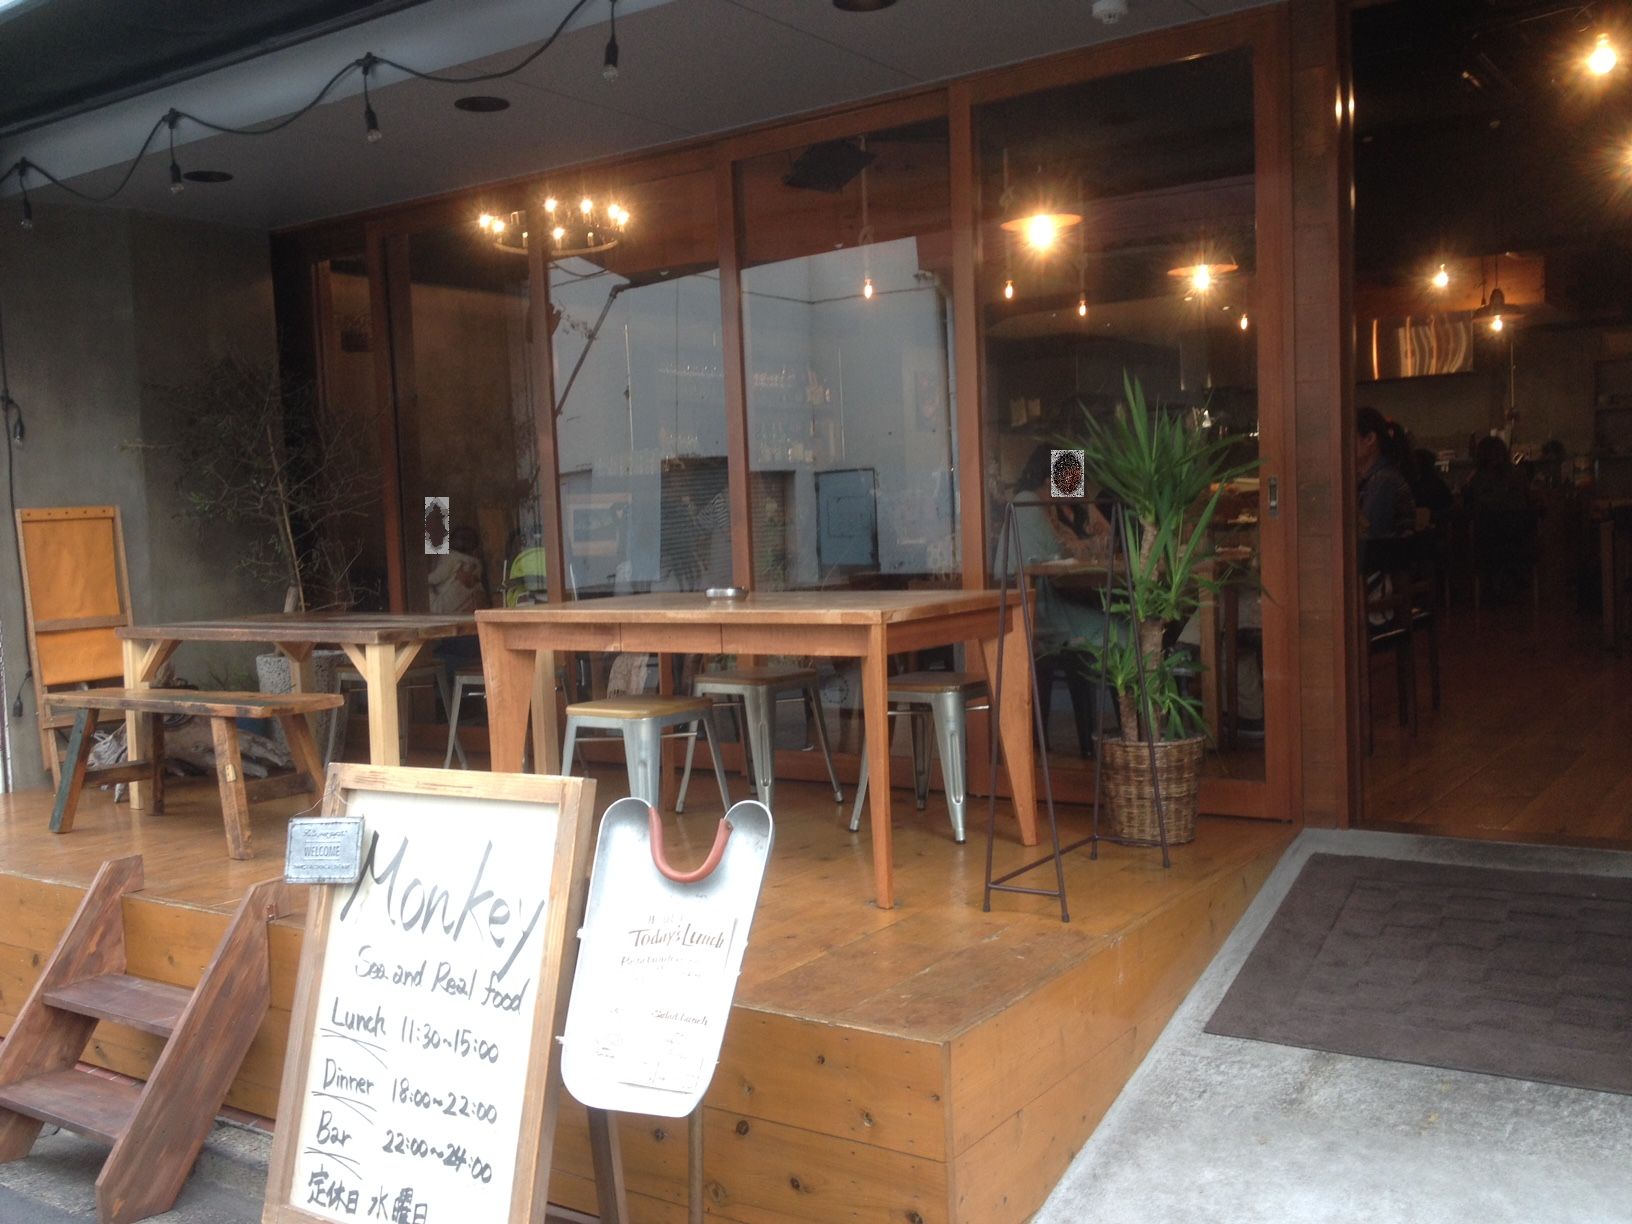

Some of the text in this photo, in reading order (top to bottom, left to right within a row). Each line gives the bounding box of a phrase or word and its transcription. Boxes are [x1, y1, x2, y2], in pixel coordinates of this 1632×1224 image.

[304, 846, 341, 857] WELCOME
[340, 830, 545, 982] Monkey
[682, 923, 725, 949] Lunch
[355, 945, 530, 1015] Sea and Real food
[331, 996, 386, 1037] Lunch
[323, 1058, 374, 1095] Dinner
[316, 1110, 352, 1147] Bar
[306, 1163, 428, 1224] 定休日 水曜日
